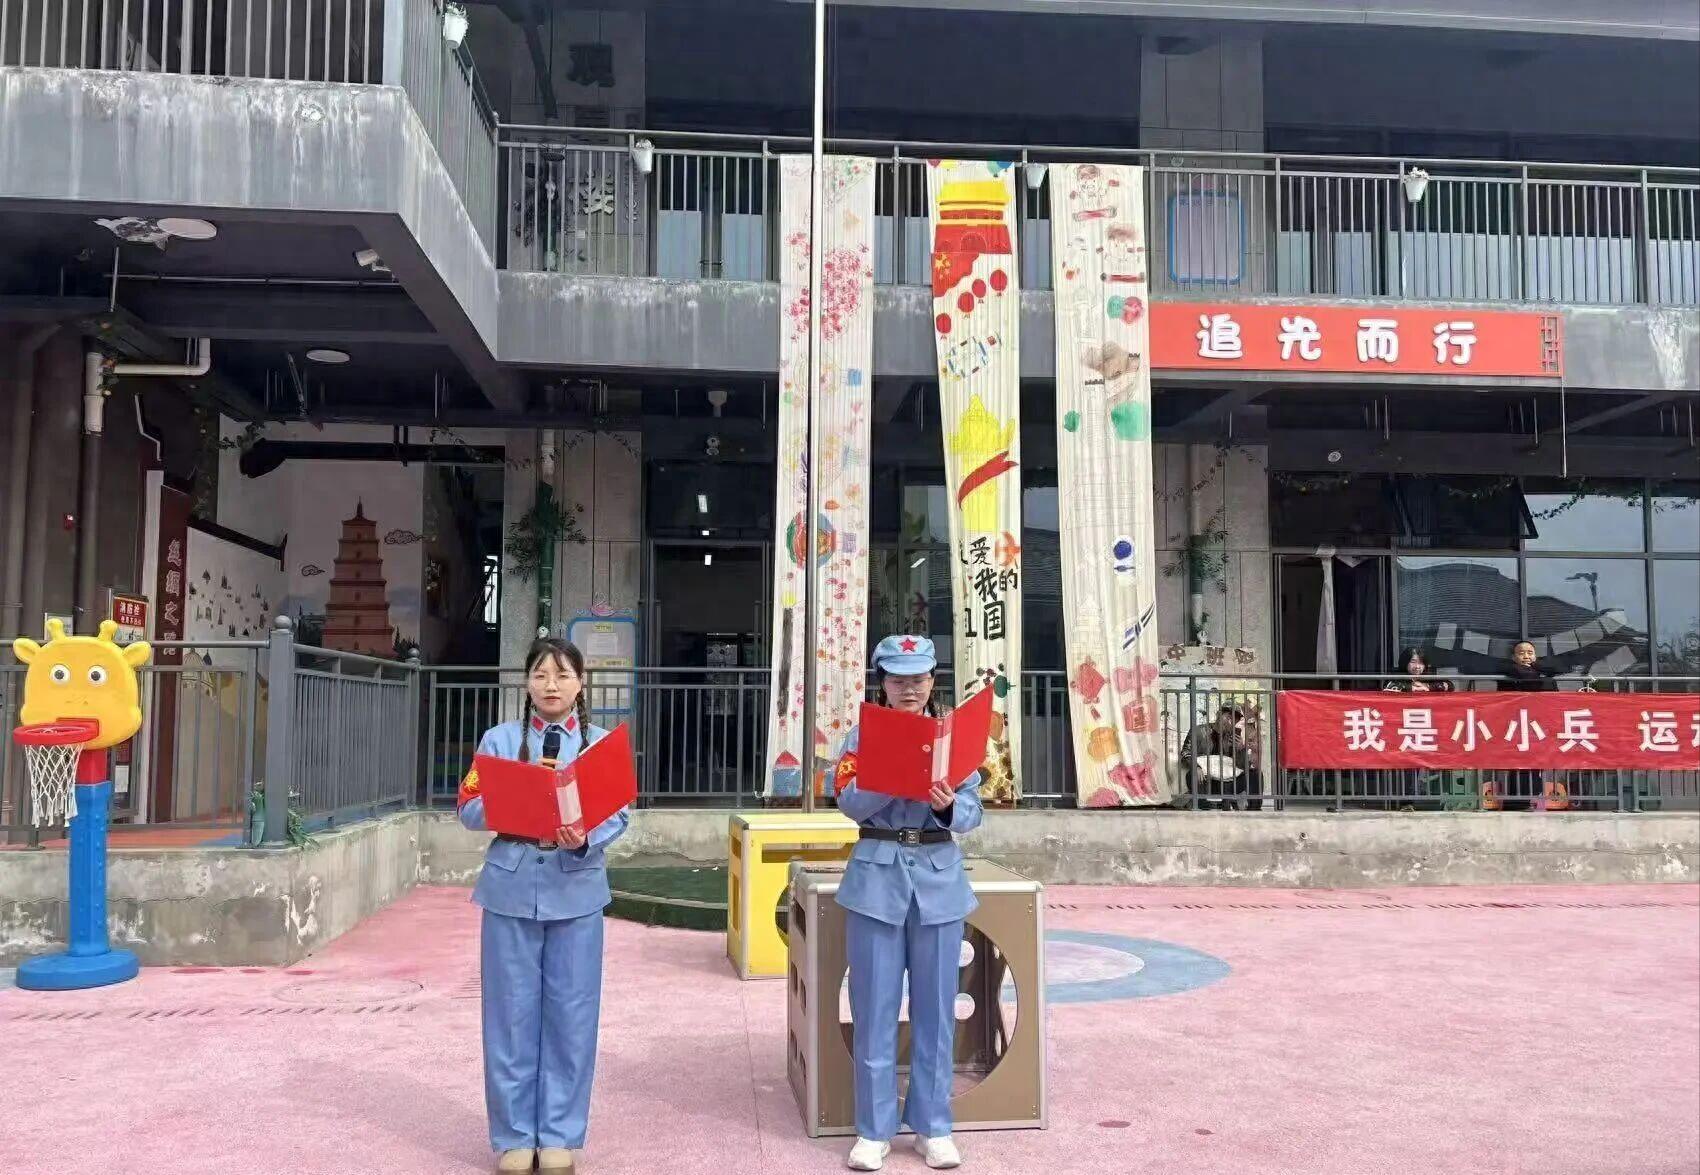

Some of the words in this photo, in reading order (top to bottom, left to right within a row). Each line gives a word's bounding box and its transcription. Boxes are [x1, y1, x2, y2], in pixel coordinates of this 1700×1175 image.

[1196, 313, 1478, 365] 追光而行
[1343, 707, 1599, 753] 我是小小兵
